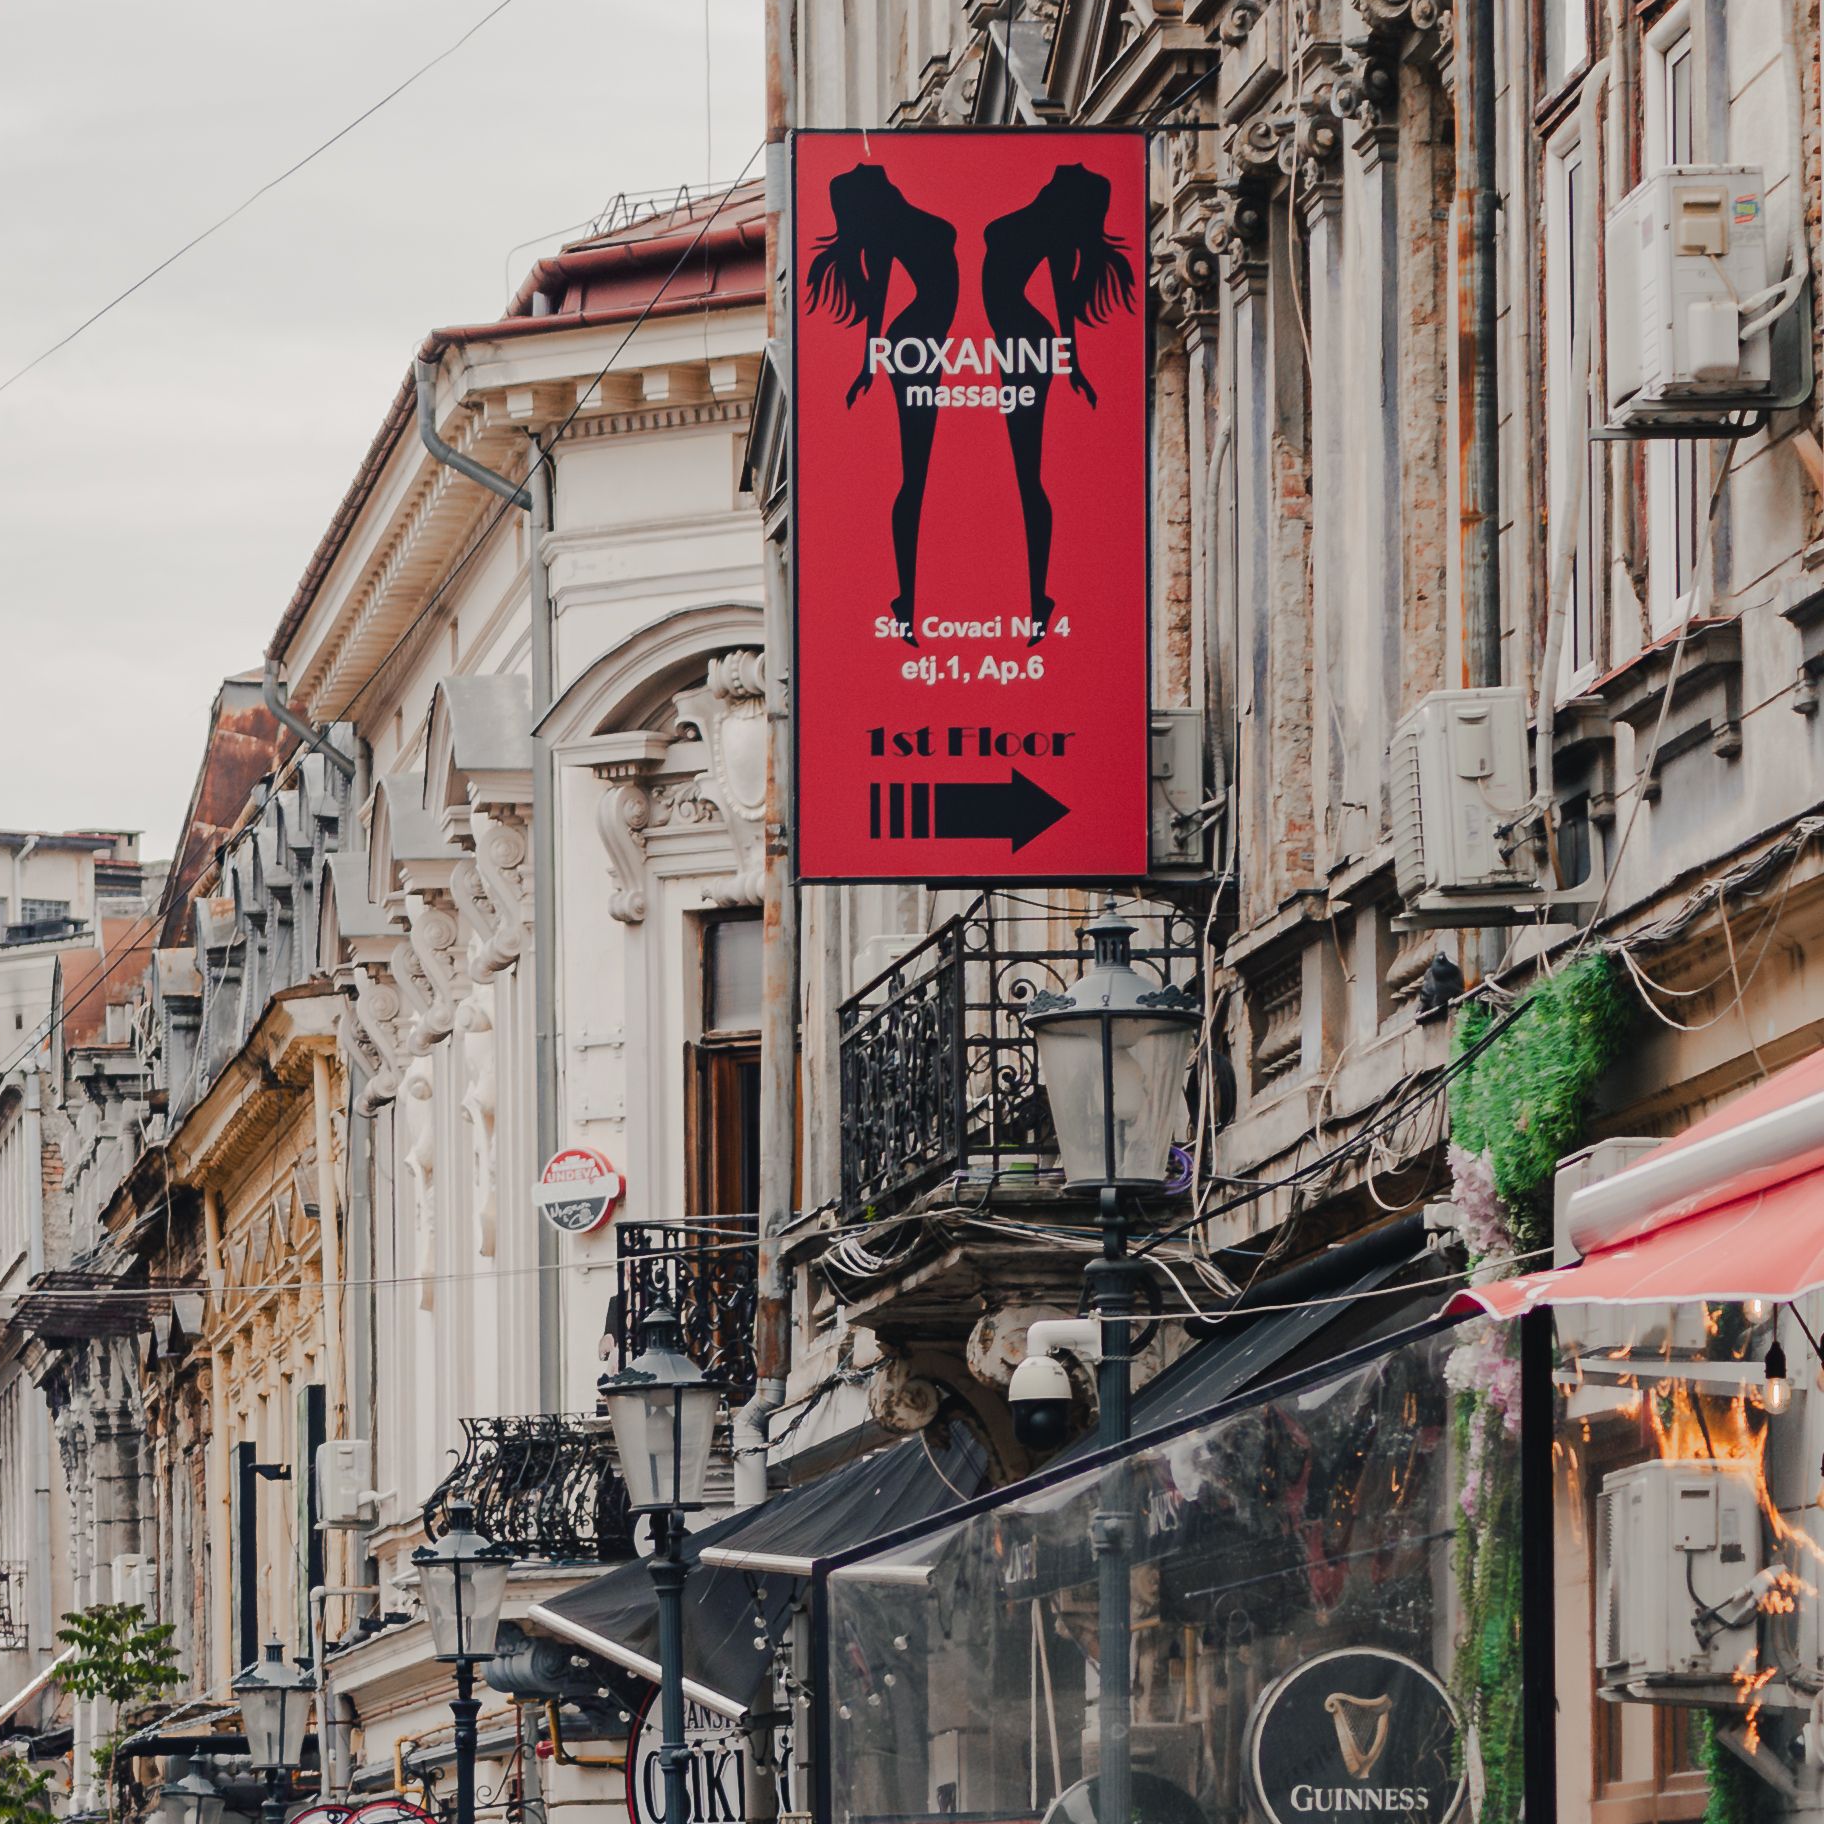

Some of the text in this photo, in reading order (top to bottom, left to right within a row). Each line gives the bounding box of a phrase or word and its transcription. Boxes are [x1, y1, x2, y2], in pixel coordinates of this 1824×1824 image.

[868, 337, 1073, 375] ROXANNE
[906, 384, 1036, 415] massage
[874, 614, 1071, 639] Str. Covaci Nr. 4
[977, 655, 1045, 685] Ap.6
[866, 726, 1076, 757] 1st Floor
[1290, 1783, 1430, 1813] GUINNESS
